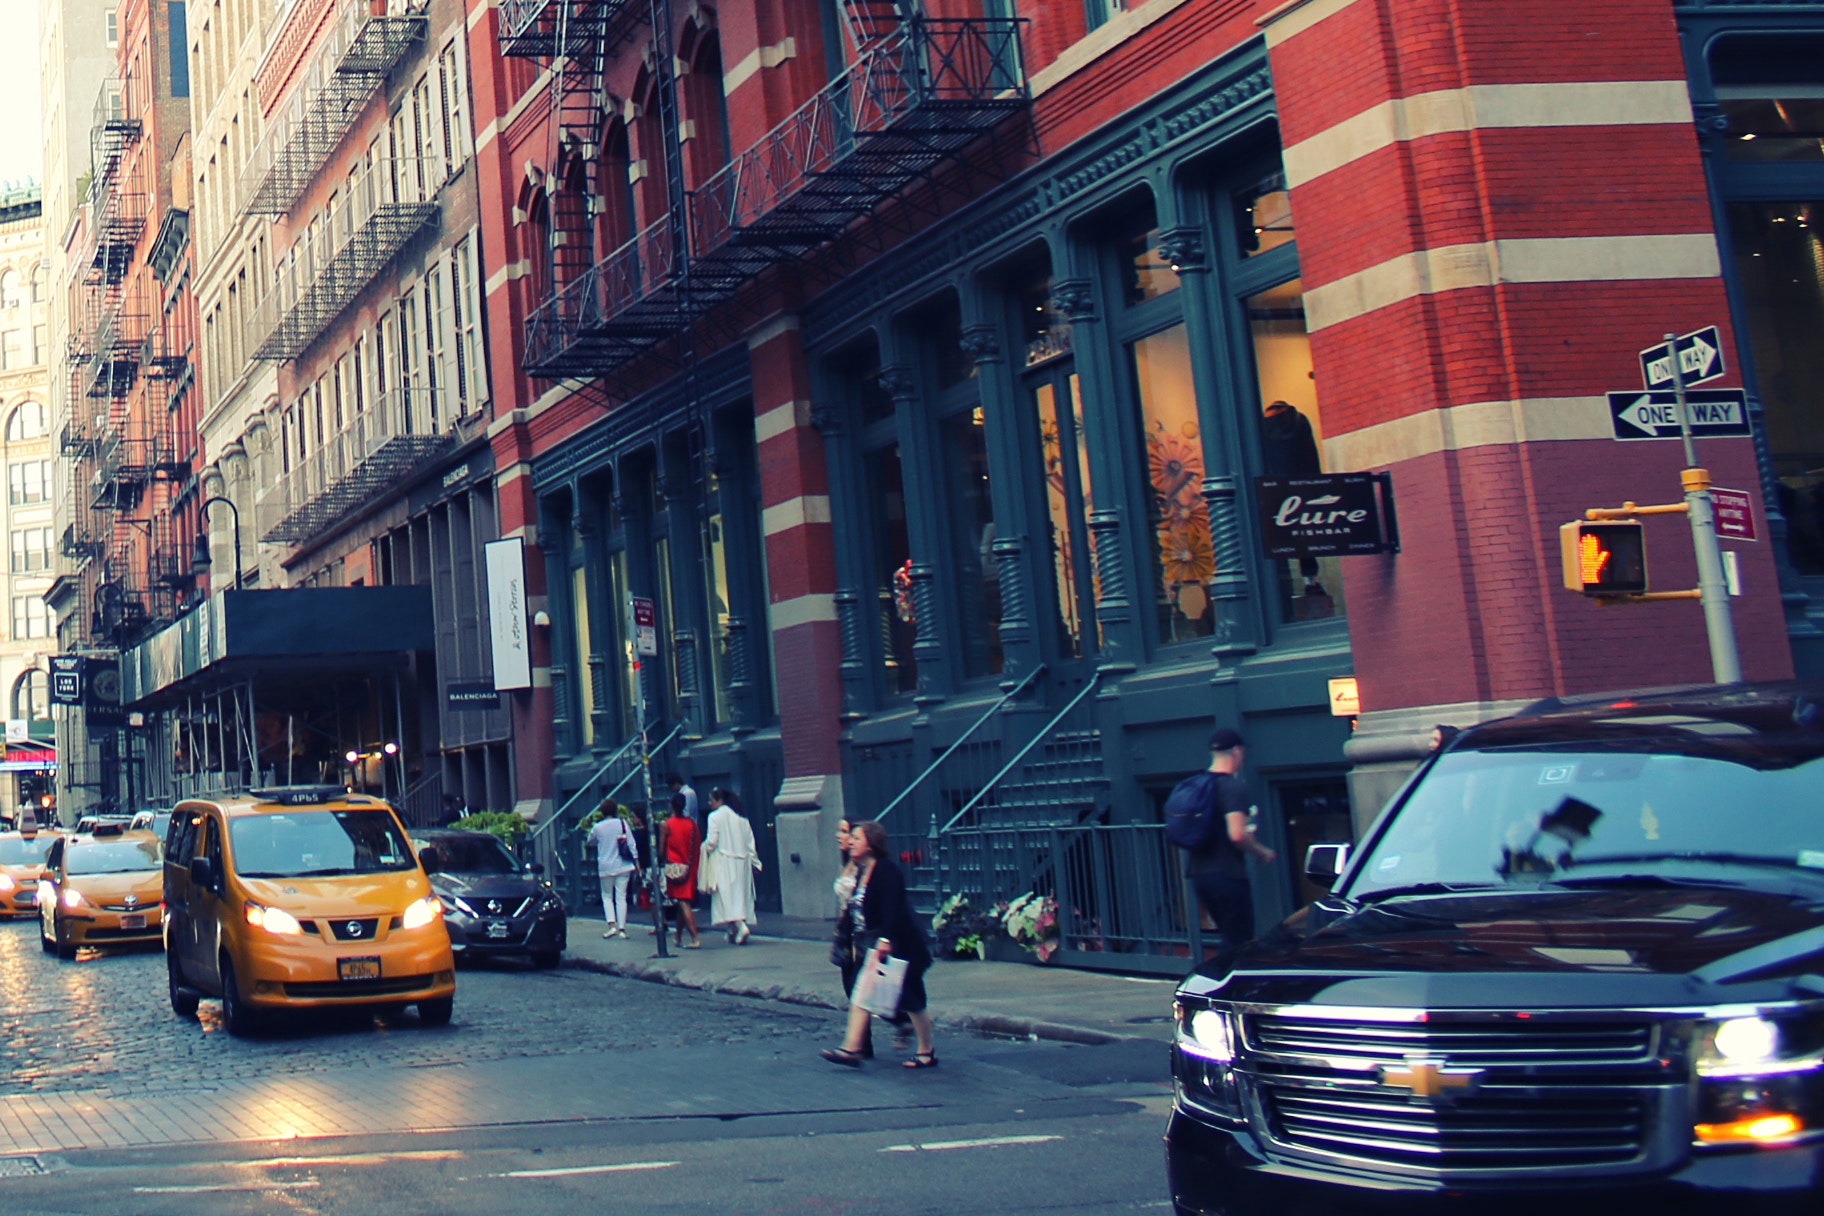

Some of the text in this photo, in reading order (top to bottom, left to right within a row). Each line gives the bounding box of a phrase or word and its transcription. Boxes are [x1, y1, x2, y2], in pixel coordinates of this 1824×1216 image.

[1652, 347, 1708, 381] ON WAY
[1637, 404, 1732, 424] ONE WAY
[1291, 527, 1352, 537] FISHBAR
[449, 692, 498, 701] BALENCIAGA
